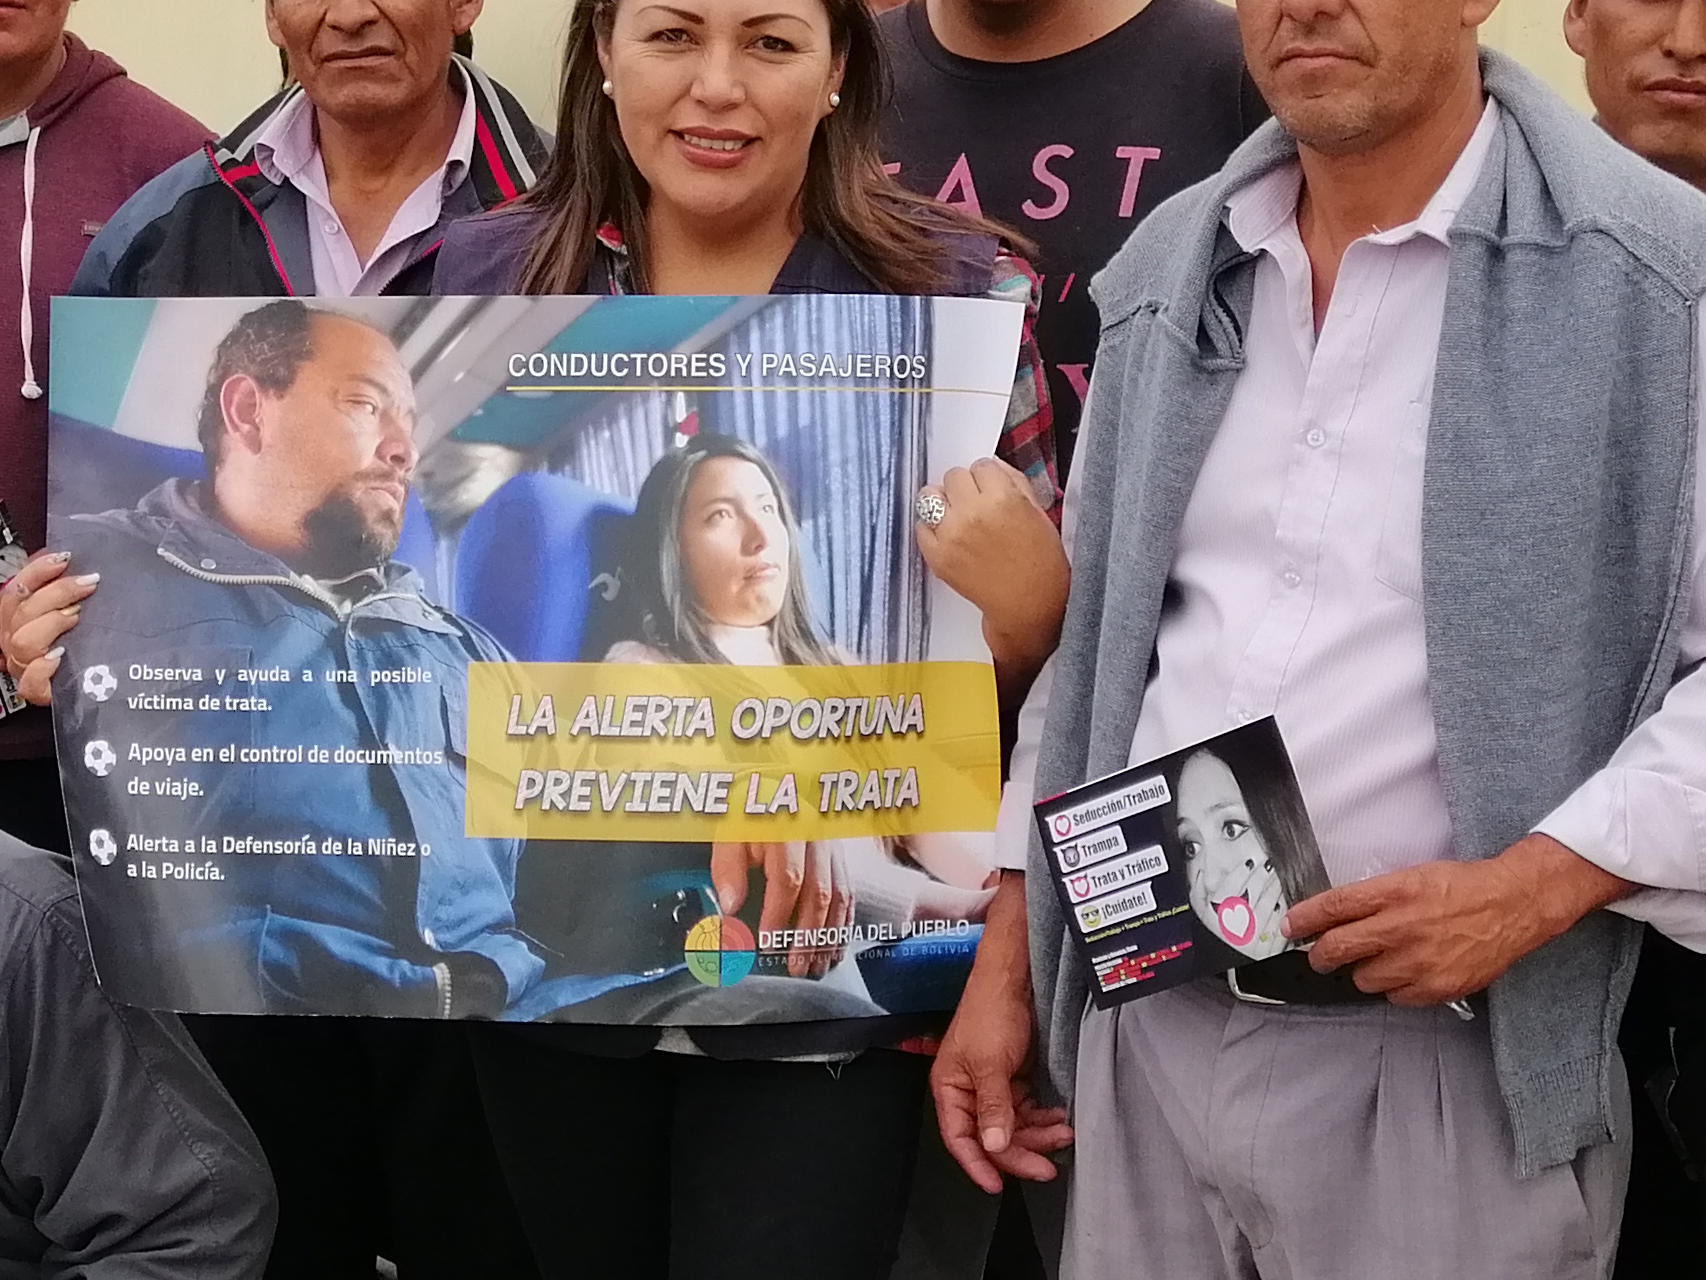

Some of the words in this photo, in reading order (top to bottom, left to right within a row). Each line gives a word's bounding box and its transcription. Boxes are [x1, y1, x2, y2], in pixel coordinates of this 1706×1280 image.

[881, 143, 1162, 221] AST
[508, 353, 726, 377] CONDUCTORES
[735, 353, 754, 377] Y
[762, 353, 927, 379] PASAJEROS
[129, 664, 203, 682] Observa
[215, 667, 226, 685] y
[237, 666, 290, 685] ayuda
[302, 670, 313, 682] a
[326, 670, 357, 682] una
[370, 667, 432, 686] posible
[128, 693, 194, 710] víctima
[199, 694, 220, 710] de
[225, 696, 272, 711] trata.
[506, 694, 557, 736] LA
[570, 695, 715, 738] ALERTA
[731, 693, 924, 740] OPORTUNA
[128, 743, 186, 765] Apoya
[192, 748, 214, 762] en
[219, 744, 235, 762] el
[240, 744, 303, 763] control
[308, 745, 329, 763] de
[334, 746, 442, 765] documentos
[128, 778, 149, 795] de
[155, 778, 204, 801] viaje.
[515, 769, 733, 813] PREVIENE
[744, 773, 798, 815] LA
[819, 767, 919, 813] TRATA
[1073, 784, 1165, 827] Seducción/Trabajo
[126, 834, 179, 853] Alerta
[184, 840, 195, 853] a
[201, 836, 217, 854] la
[223, 834, 316, 855] Defensoría
[321, 838, 342, 855] de
[348, 838, 363, 855] la
[368, 838, 416, 856] Niñez
[421, 844, 431, 856] o
[1081, 835, 1120, 858] Trampa
[126, 866, 138, 878] a
[142, 862, 157, 878] la
[162, 861, 225, 880] Policía.
[1091, 868, 1118, 889] Trata
[1118, 866, 1126, 880] y
[1125, 856, 1162, 876] Tráfico
[758, 921, 864, 949] DEFENSORÍA
[869, 923, 897, 941] DEL
[901, 919, 971, 939] PUEBLO
[758, 955, 805, 967] ESTADO
[810, 944, 896, 963] PLURICIONAL
[902, 946, 917, 957] DE
[922, 944, 971, 956] BOLIVIA
